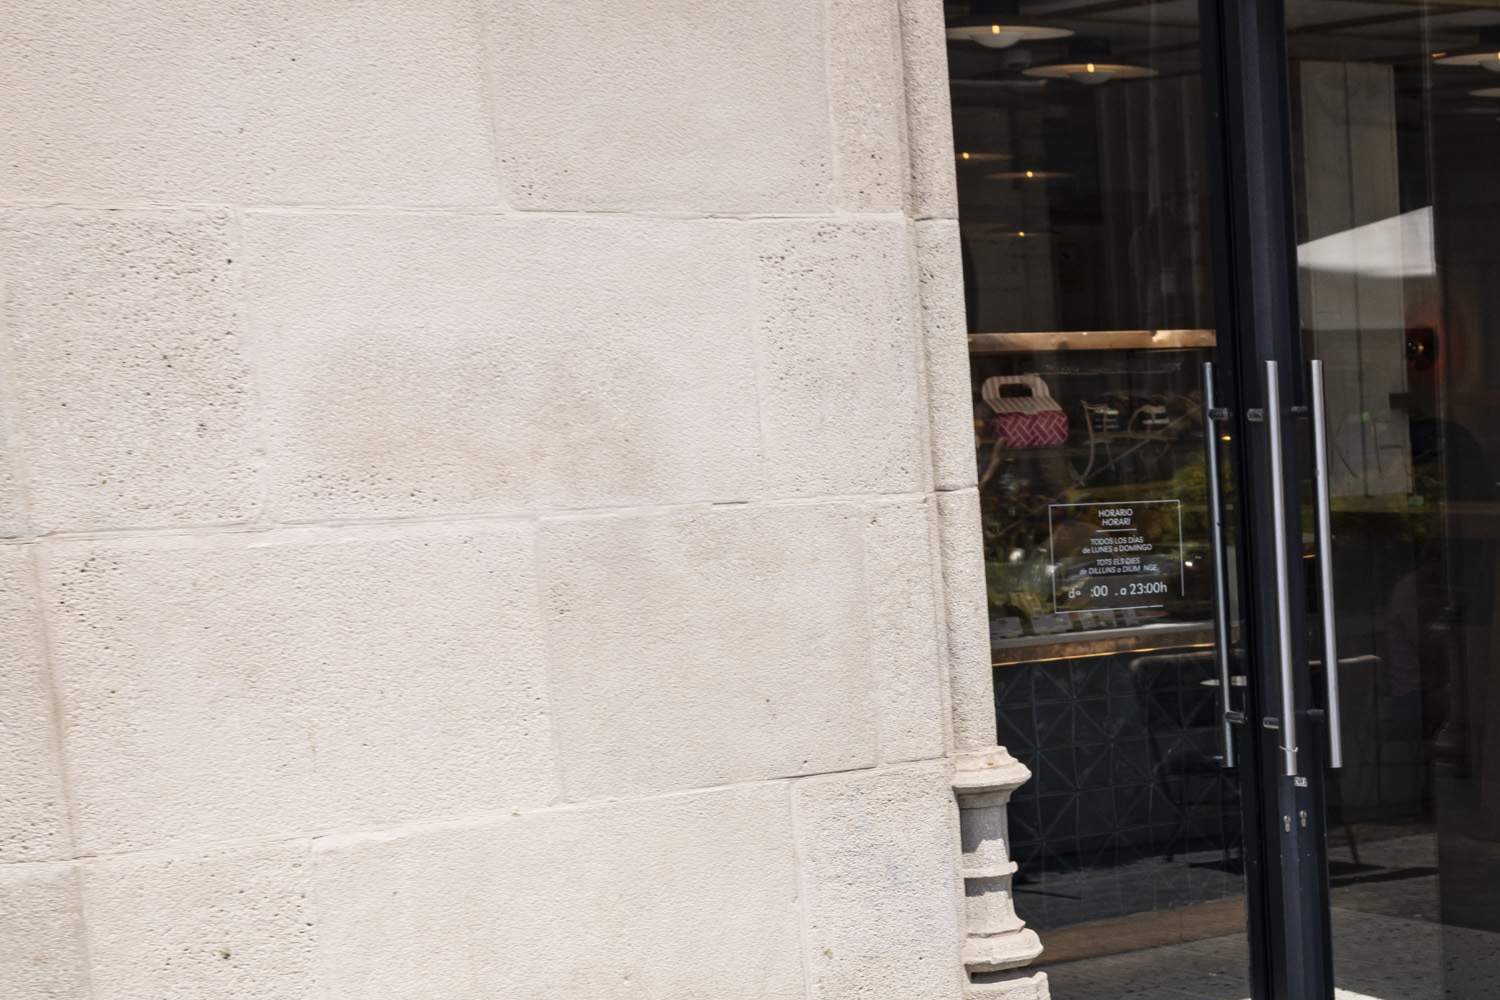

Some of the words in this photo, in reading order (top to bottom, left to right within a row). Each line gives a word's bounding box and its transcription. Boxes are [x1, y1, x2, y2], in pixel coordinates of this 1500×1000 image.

[1098, 508, 1133, 517] HORARIO
[1101, 517, 1131, 526] HORARI
[1090, 538, 1113, 546] TODOS
[1114, 537, 1126, 545] LOS
[1127, 534, 1144, 544] DÍAS
[1082, 546, 1091, 554] de
[1091, 545, 1113, 553] LUNES
[1119, 543, 1152, 552] DOMINGO
[1096, 558, 1112, 567] TOTS
[1113, 557, 1124, 566] ELS
[1125, 557, 1140, 565] DIES
[1088, 567, 1115, 576] DILLUNS
[1122, 564, 1158, 573] DIUMNGE
[1120, 587, 1127, 595] a
[1129, 582, 1168, 595] 23:00h
